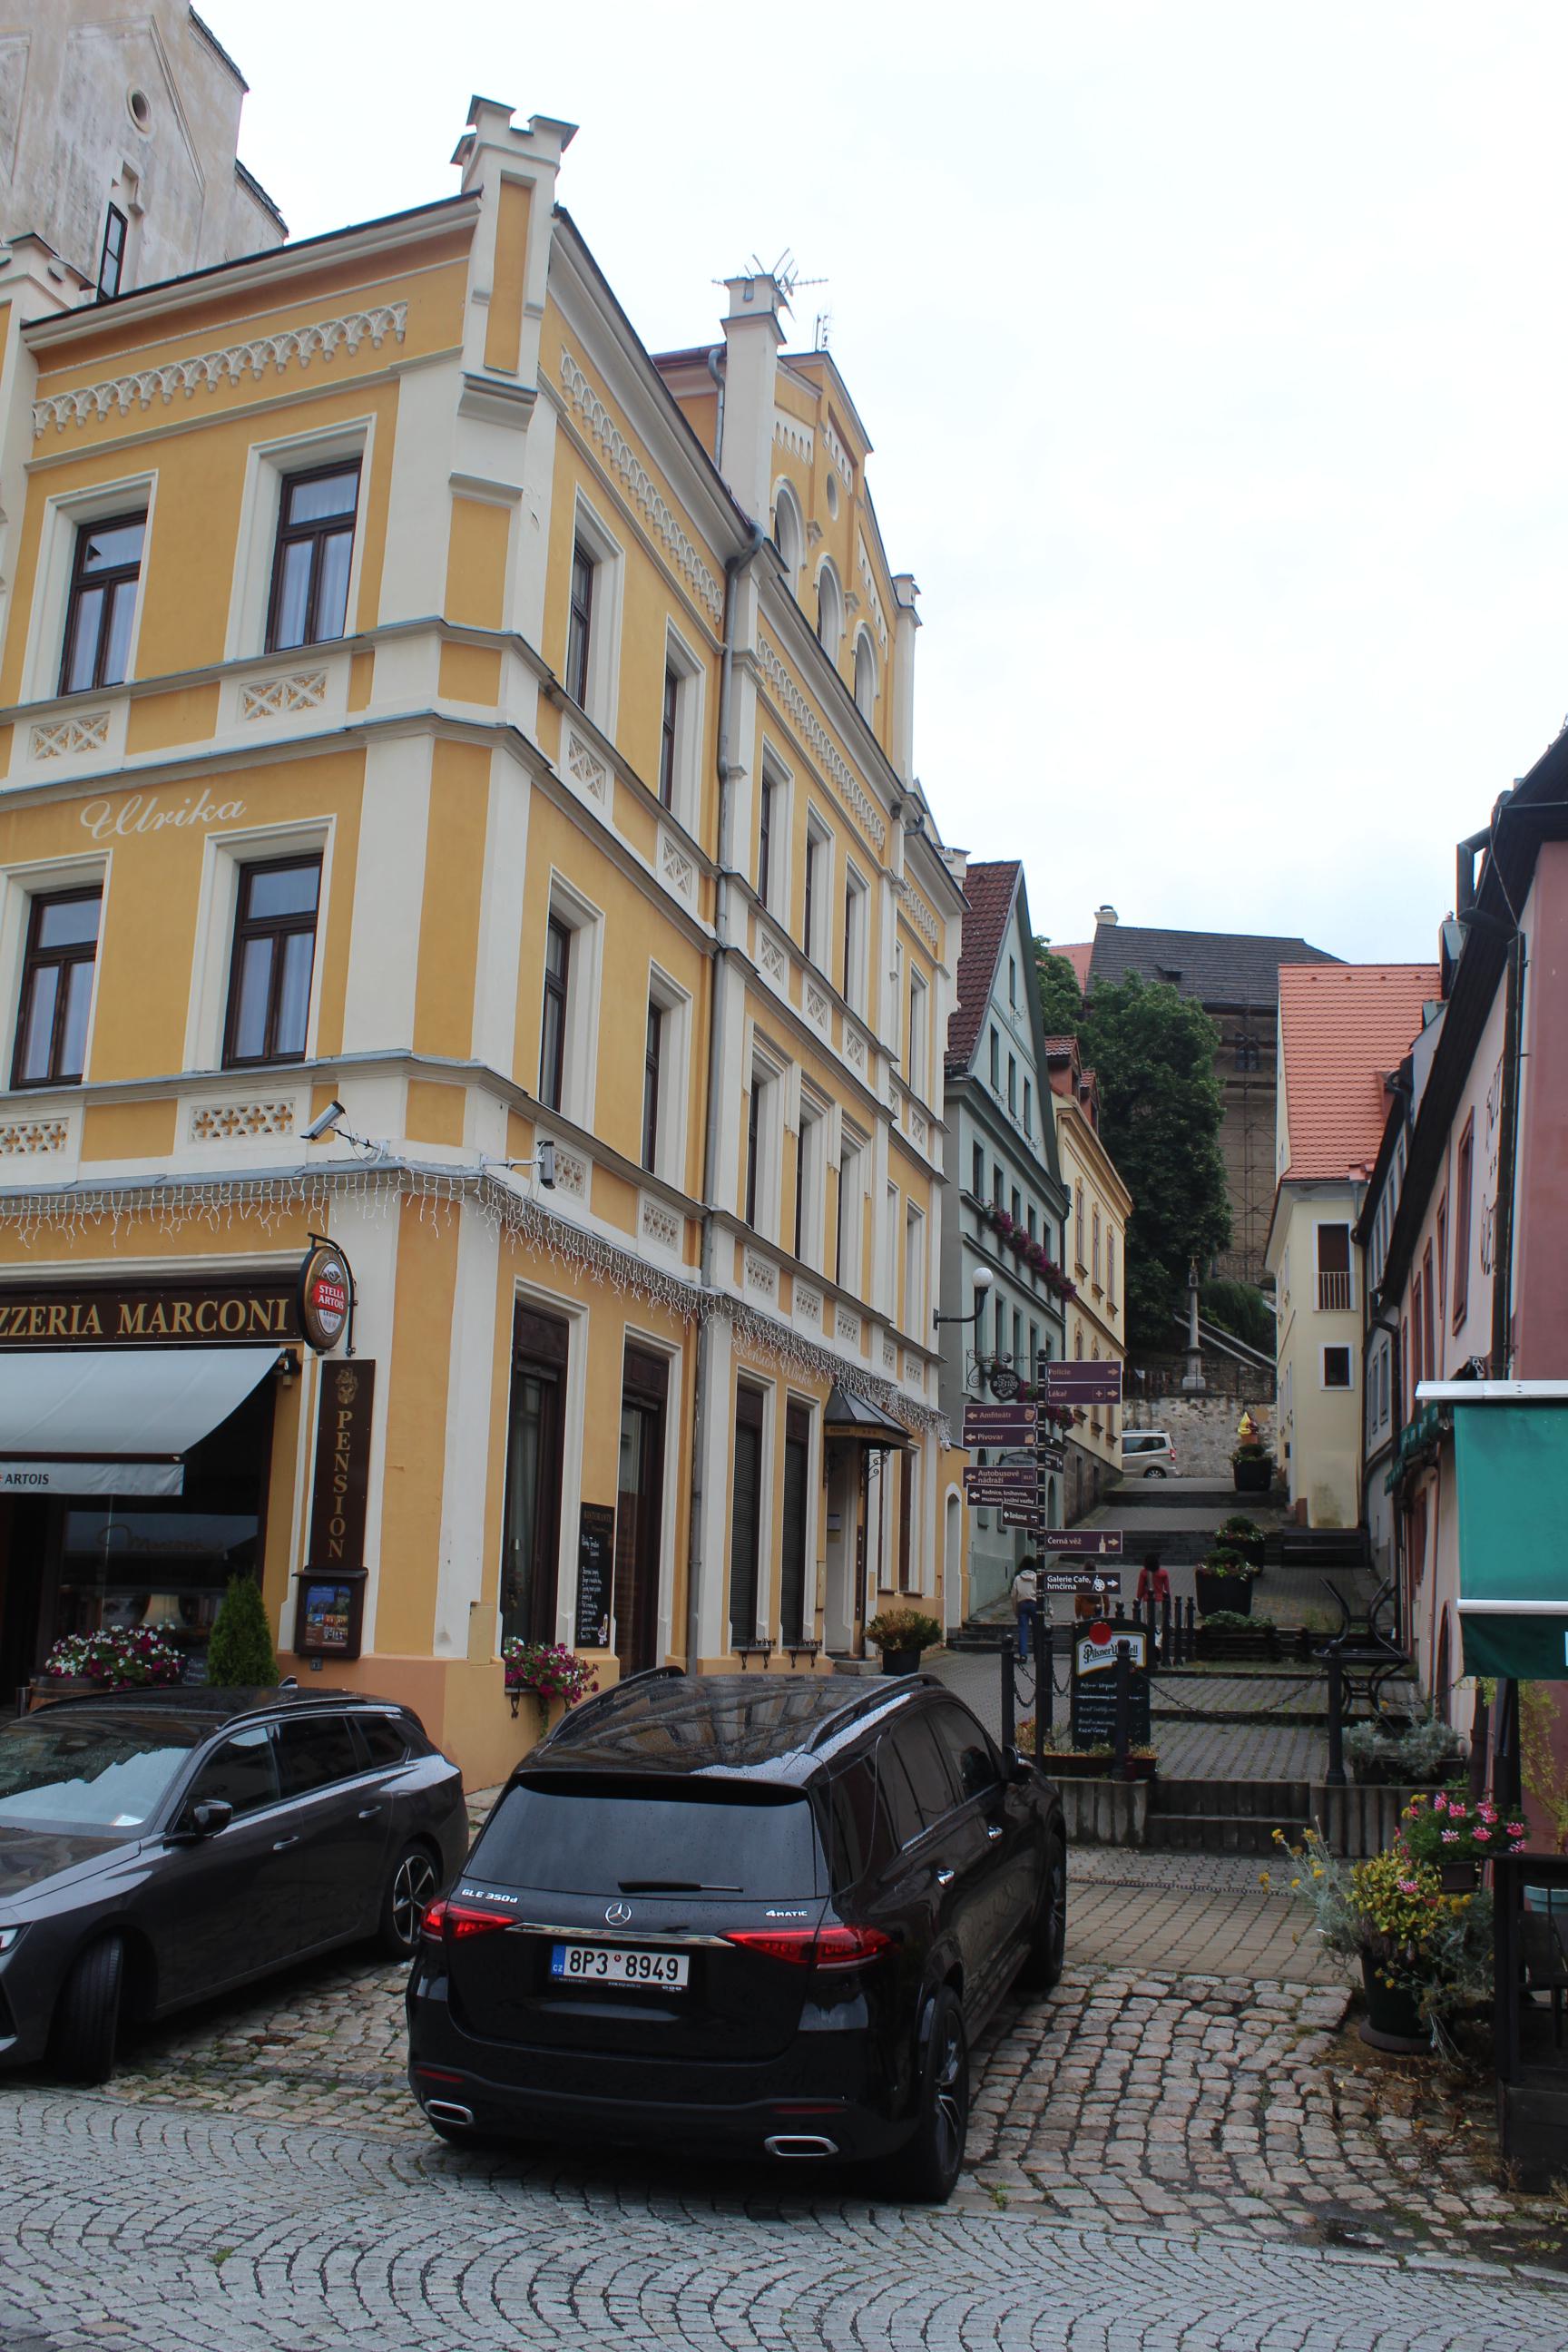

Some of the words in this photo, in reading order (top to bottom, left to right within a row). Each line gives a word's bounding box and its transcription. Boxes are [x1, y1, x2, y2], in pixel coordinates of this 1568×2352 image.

[80, 789, 247, 839] Ulrika
[319, 1285, 345, 1300] STELLA
[318, 1295, 344, 1310] ARTOIS
[116, 1298, 289, 1335] MARCONI
[1048, 1389, 1067, 1397] Lékař
[977, 1469, 1020, 1477] Autobusové
[5, 1474, 49, 1485] ARTOIS
[328, 1410, 354, 1559] PENSION
[1047, 1536, 1068, 1545] Černá
[1069, 1537, 1082, 1545] věž
[1047, 1574, 1073, 1583] Galerie
[1073, 1575, 1091, 1584] Cafe,
[1047, 1582, 1077, 1590] hrnčírna
[1083, 1644, 1112, 1664] Pilsner
[1111, 1644, 1138, 1655] Uell
[461, 1888, 485, 1898] GLE
[765, 1909, 808, 1917] 4MATIC
[553, 1964, 564, 1972] CZ
[569, 1949, 609, 1975] 8P3
[624, 1955, 679, 1981] 8949
